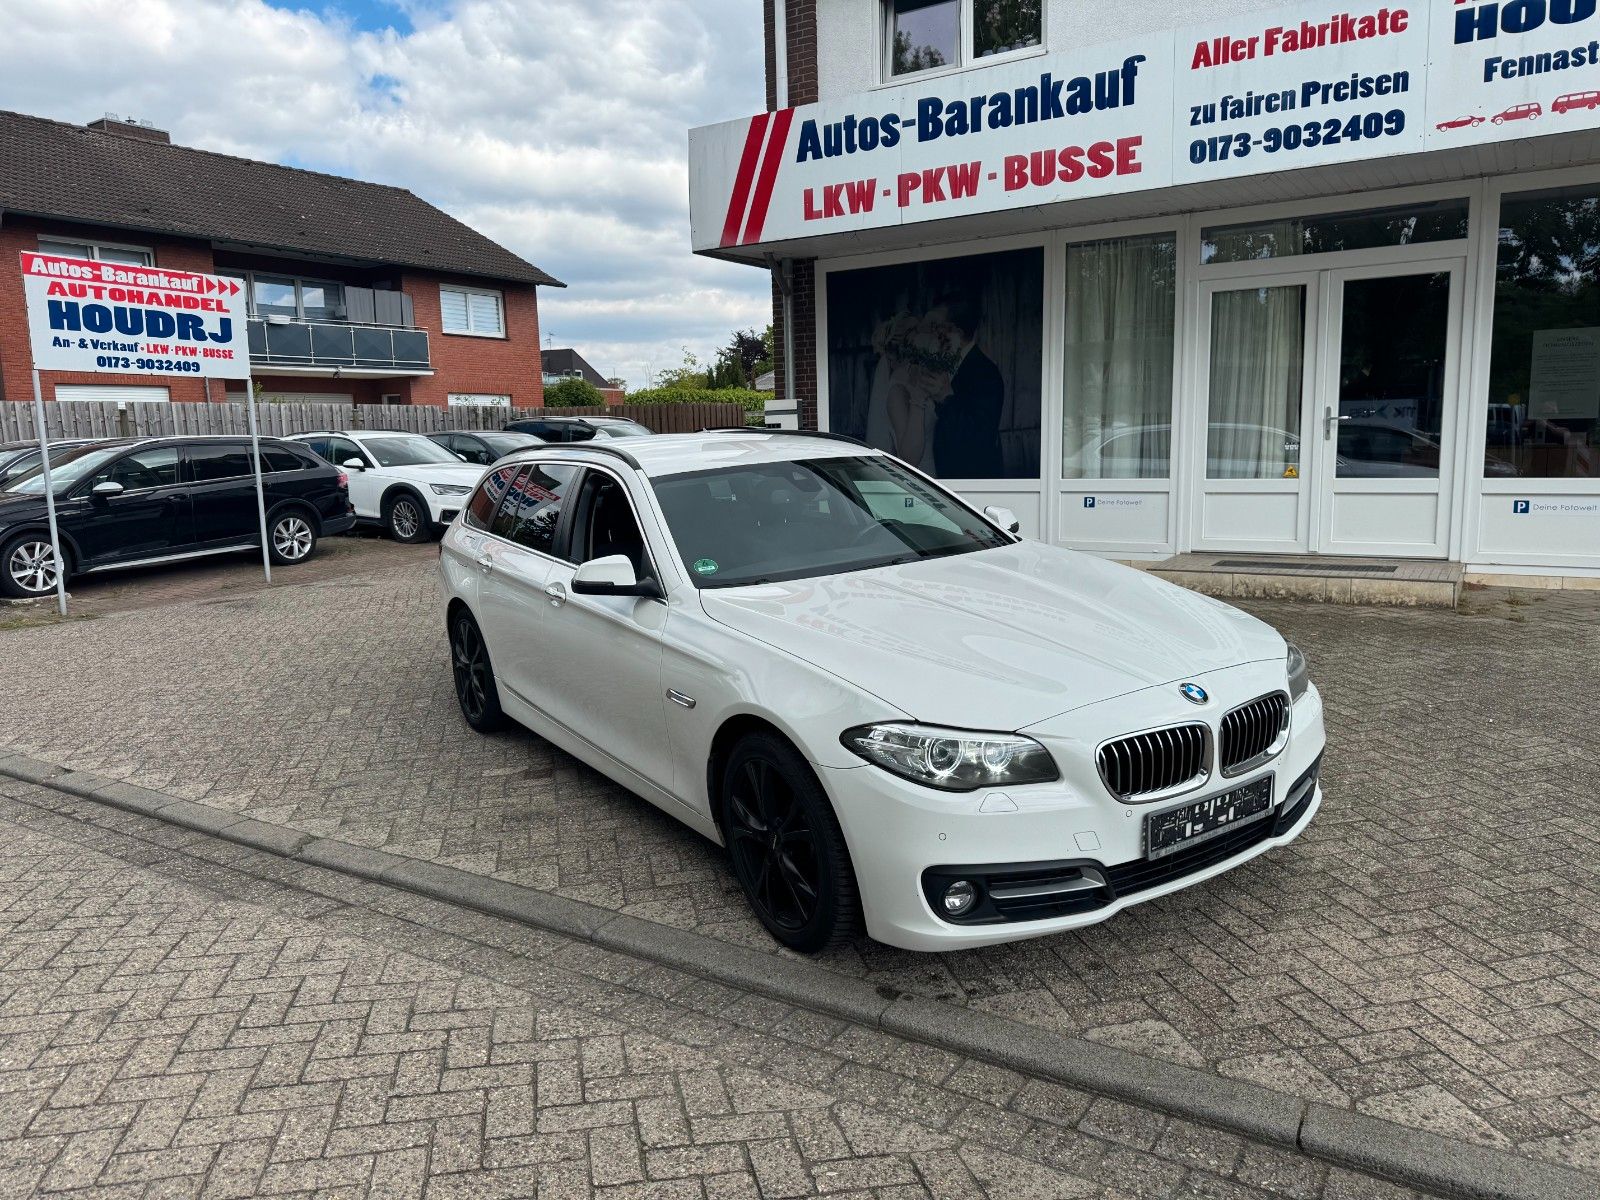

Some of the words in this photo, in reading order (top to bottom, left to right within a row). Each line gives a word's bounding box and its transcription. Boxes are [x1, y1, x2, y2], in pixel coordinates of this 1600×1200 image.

[1191, 36, 1260, 70] Aller
[1263, 8, 1409, 57] Fabrikate
[796, 54, 1146, 163] Autos-Barankauf
[1189, 101, 1216, 126] zu
[1220, 88, 1296, 122] fairen
[1301, 70, 1410, 109] Preisen
[1189, 108, 1406, 165] 0173-9032409
[803, 177, 877, 221] LKW
[897, 160, 982, 207] PKW
[1004, 135, 1143, 192] BUSSE
[30, 257, 201, 292] Autos-Barankauf
[47, 281, 231, 313] AUTOHANDEL
[47, 299, 233, 343] HOUDRJ
[52, 336, 75, 348] An-
[78, 338, 88, 349] &
[90, 339, 140, 353] Verkauf
[146, 343, 169, 354] LKW
[175, 345, 197, 356] PKW
[203, 347, 234, 359] BUSSE
[96, 355, 200, 372] 0173-9032409
